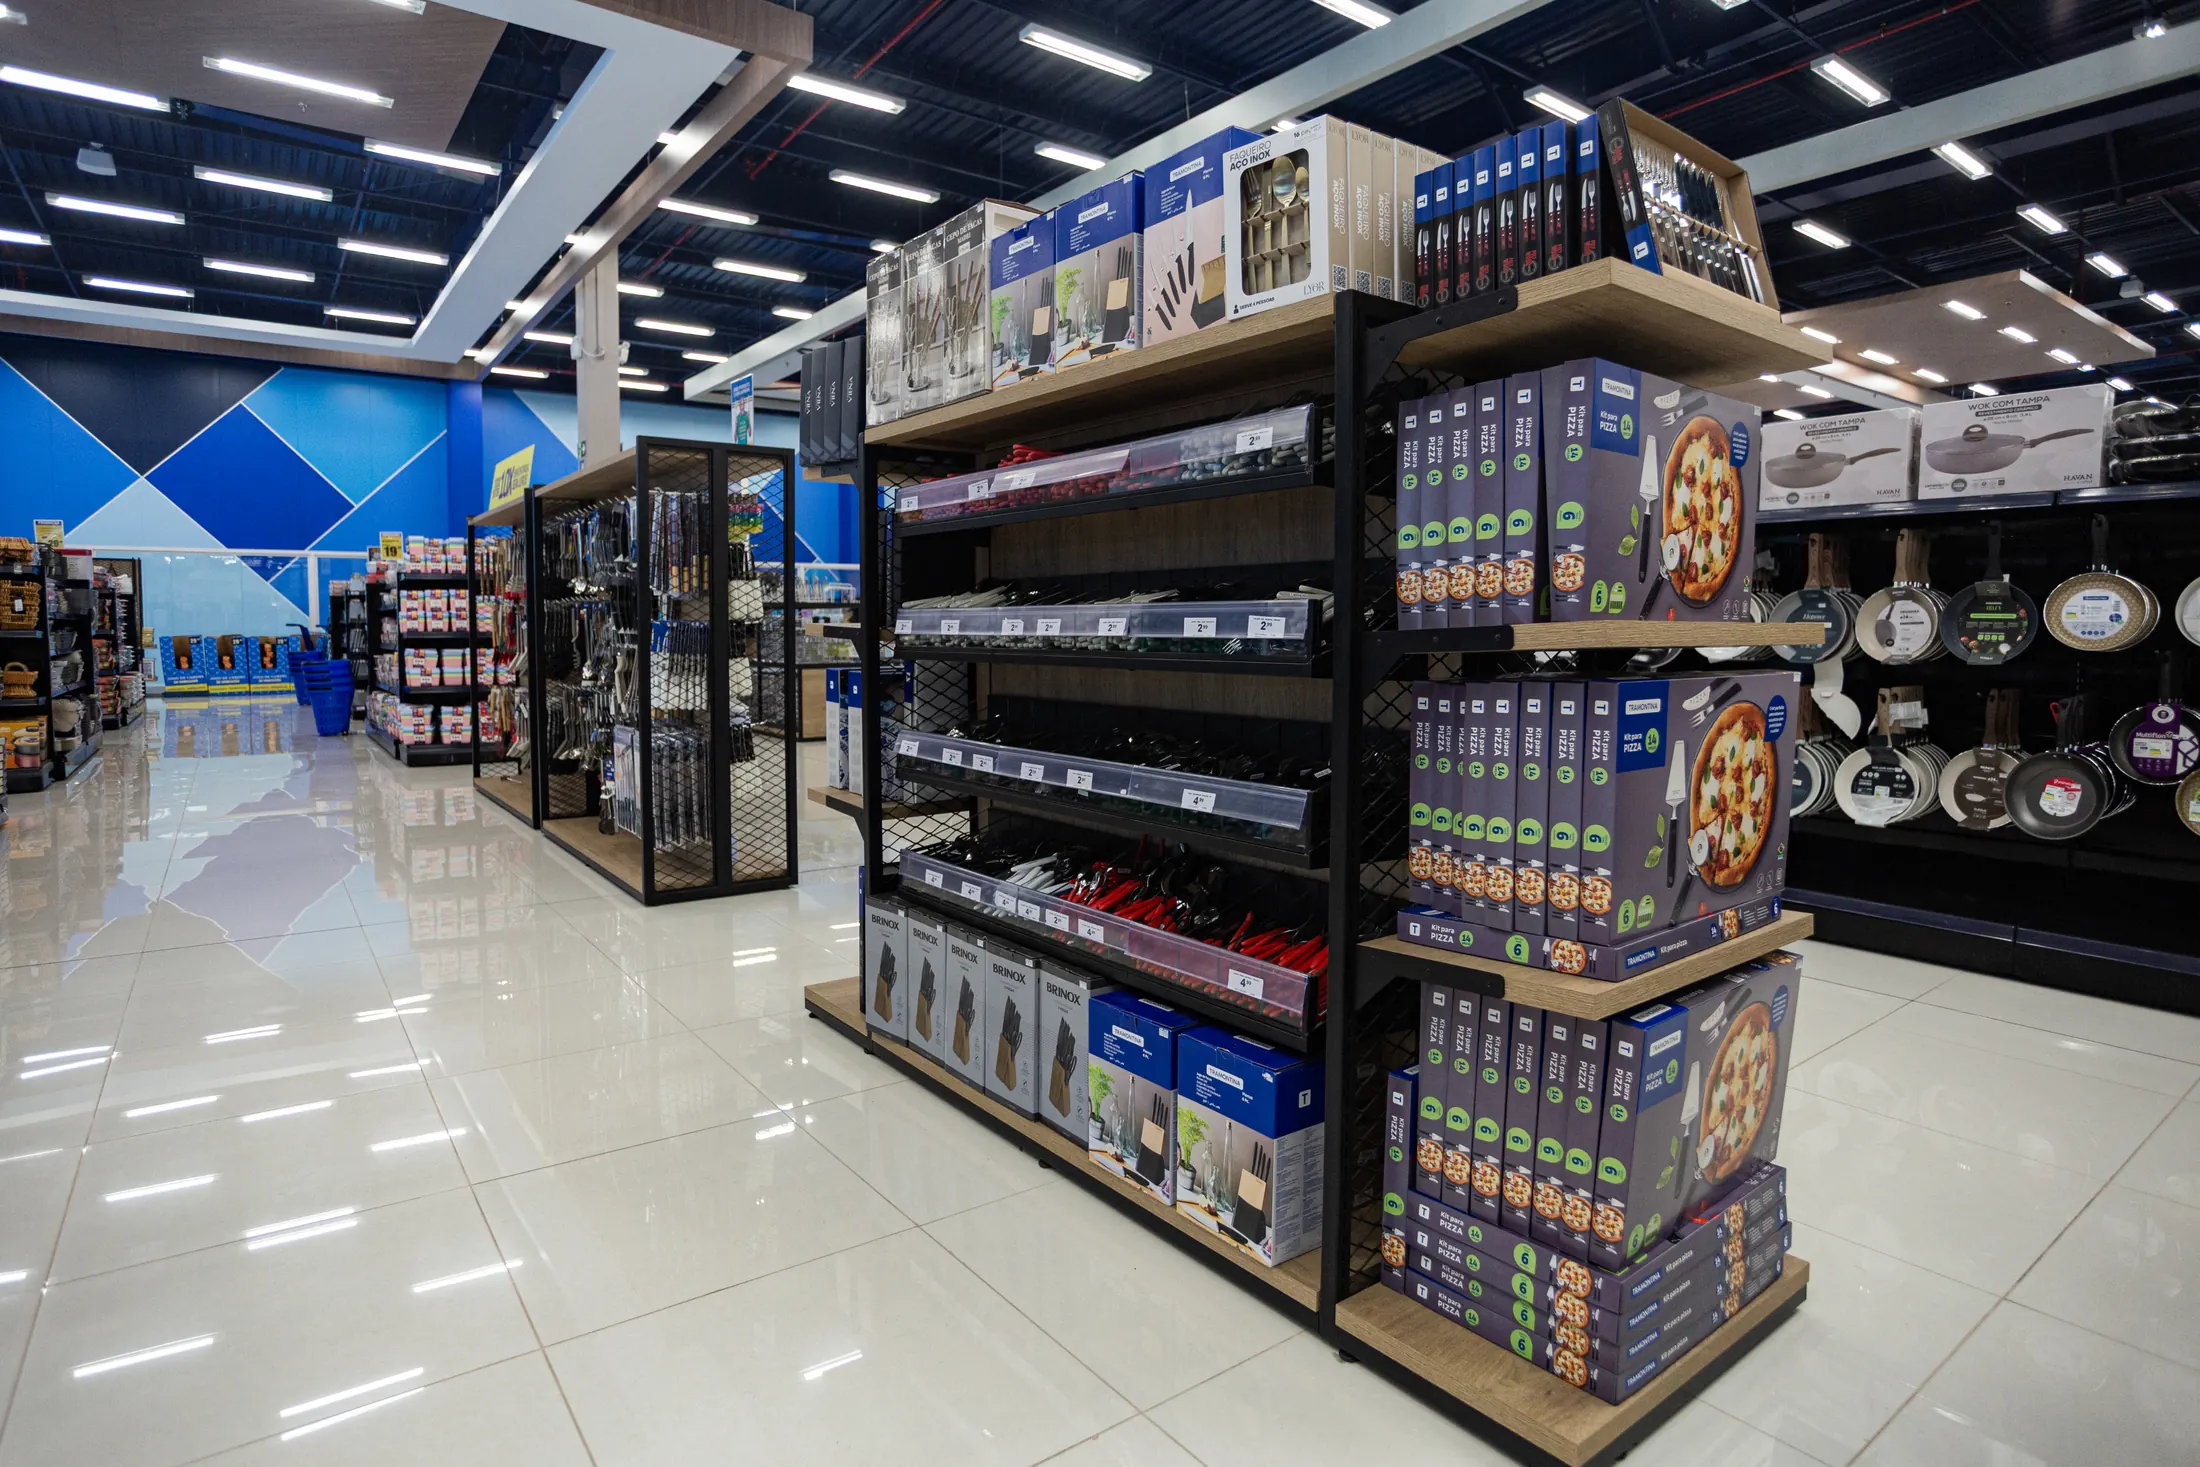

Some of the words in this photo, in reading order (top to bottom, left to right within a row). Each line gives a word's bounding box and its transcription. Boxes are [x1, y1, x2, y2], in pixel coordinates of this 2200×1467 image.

[1229, 140, 1272, 163] FAQUEIRO
[1229, 157, 1248, 172] AÇO
[1249, 149, 1271, 164] INOX
[1172, 160, 1202, 179] TRAMONTINA
[1080, 205, 1107, 222] TRAMONTINA
[1338, 177, 1347, 235] FAQUEIRO
[1362, 184, 1370, 240] FAQUEIRO
[946, 229, 960, 242] CEPO
[1303, 281, 1325, 295] LYOR
[1605, 382, 1631, 396] TRAMONTINA
[1578, 405, 1586, 417] Kit
[1968, 402, 1991, 411] WOK
[1992, 399, 2014, 408] COM
[2016, 395, 2051, 406] TAMPA
[1566, 406, 1576, 438] PIZZA
[1600, 421, 1617, 433] PIZZA
[1607, 414, 1618, 422] para
[1800, 423, 1817, 431] WOK
[1818, 420, 1837, 429] COM
[1838, 417, 1866, 427] TAMPA
[1480, 425, 1488, 454] PIZZA
[1515, 417, 1524, 448] PIZZA
[2063, 473, 2093, 481] HAVAN
[384, 546, 398, 557] 19
[1628, 703, 1658, 712] TRAMONTINA
[1470, 727, 1478, 756] PIZZA
[1494, 727, 1502, 757] PIZZA
[1525, 727, 1533, 757] PIZZA
[1558, 729, 1568, 760] PIZZA
[1591, 729, 1601, 760] PIZZA
[1623, 733, 1631, 741] Kit
[1631, 733, 1642, 742] para
[1623, 743, 1642, 753] PIZZA
[871, 914, 900, 932] BRINOX
[1623, 911, 1629, 924] 6
[912, 927, 939, 947] BRINOX
[1430, 923, 1440, 932] Kit
[1440, 925, 1455, 936] para
[1430, 932, 1454, 944] PIZZA
[951, 944, 978, 964] BRINOX
[1513, 943, 1522, 956] 6
[1627, 951, 1655, 966] TRAMONTINA
[1660, 945, 1668, 954] Kit
[1667, 942, 1677, 953] para
[1677, 939, 1688, 950] pizza
[992, 963, 1026, 986] BRINOX
[1046, 981, 1081, 1006] BRINOX
[1652, 1034, 1679, 1052] TRAMONTINA
[1516, 1042, 1525, 1070] PIZZA
[1549, 1051, 1558, 1080] PIZZA
[1578, 1060, 1587, 1089] PIZZA
[1209, 1067, 1241, 1086] TRAMONTINA
[1612, 1068, 1623, 1097] PIZZA
[1623, 1084, 1631, 1101] para
[1645, 1080, 1663, 1093] PIZZA
[1439, 1219, 1463, 1236] PIZZA
[1440, 1211, 1451, 1222] Kit
[1450, 1215, 1464, 1227] para
[1438, 1247, 1462, 1264] PIZZA
[1521, 1252, 1529, 1266] 6
[1441, 1272, 1464, 1290] PIZZA
[1632, 1272, 1662, 1294] TRAMONTINA
[1665, 1263, 1674, 1272] Kit
[1674, 1257, 1683, 1269] para
[1682, 1250, 1693, 1264] pizza
[1437, 1300, 1461, 1318] PIZZA
[1628, 1302, 1658, 1328] TRAMONTINA
[1628, 1331, 1658, 1356] TRAMONTINA
[1627, 1361, 1656, 1387] TRAMONTINA
